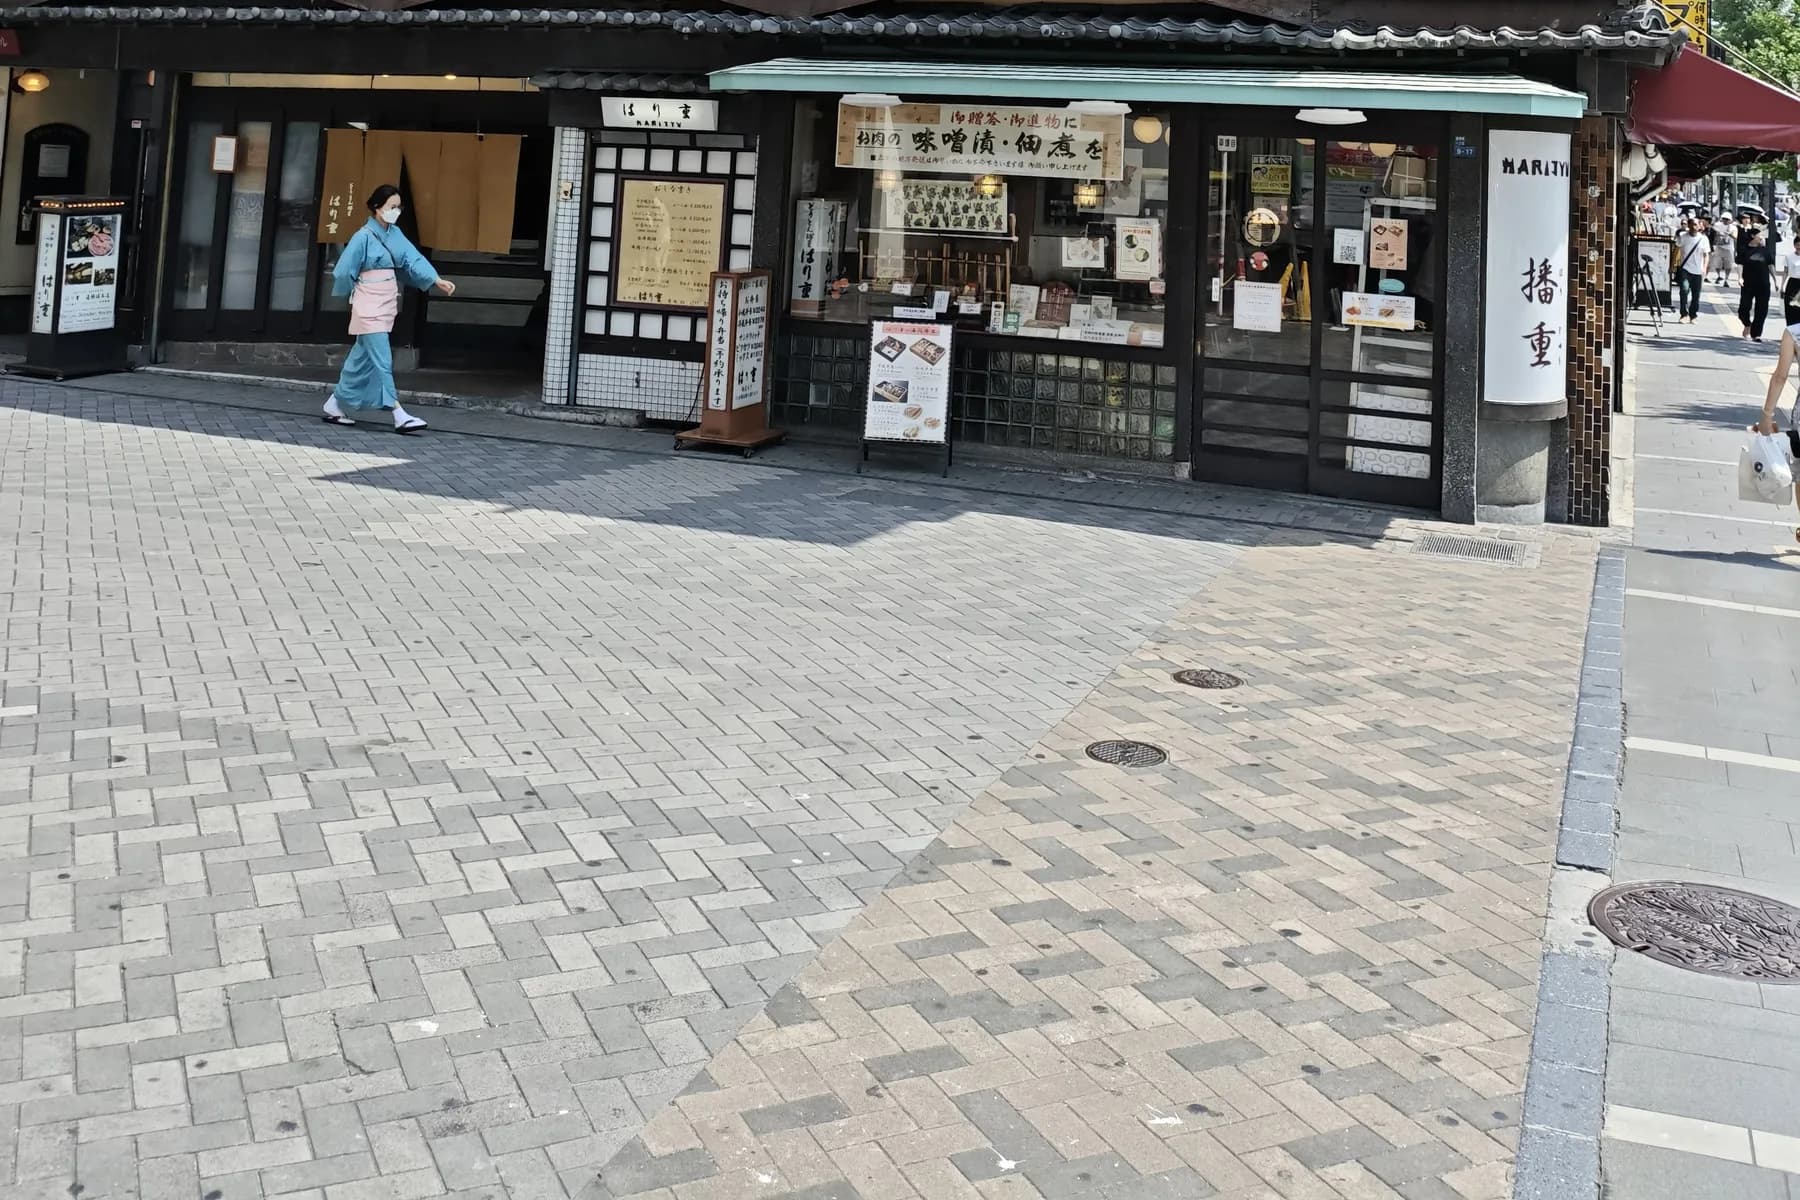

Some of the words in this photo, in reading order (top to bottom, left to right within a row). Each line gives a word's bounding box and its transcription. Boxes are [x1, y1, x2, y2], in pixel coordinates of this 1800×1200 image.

[623, 103, 691, 119] はり重
[326, 195, 340, 234] はり重
[798, 248, 815, 298] はり重
[1521, 257, 1558, 368] 播重
